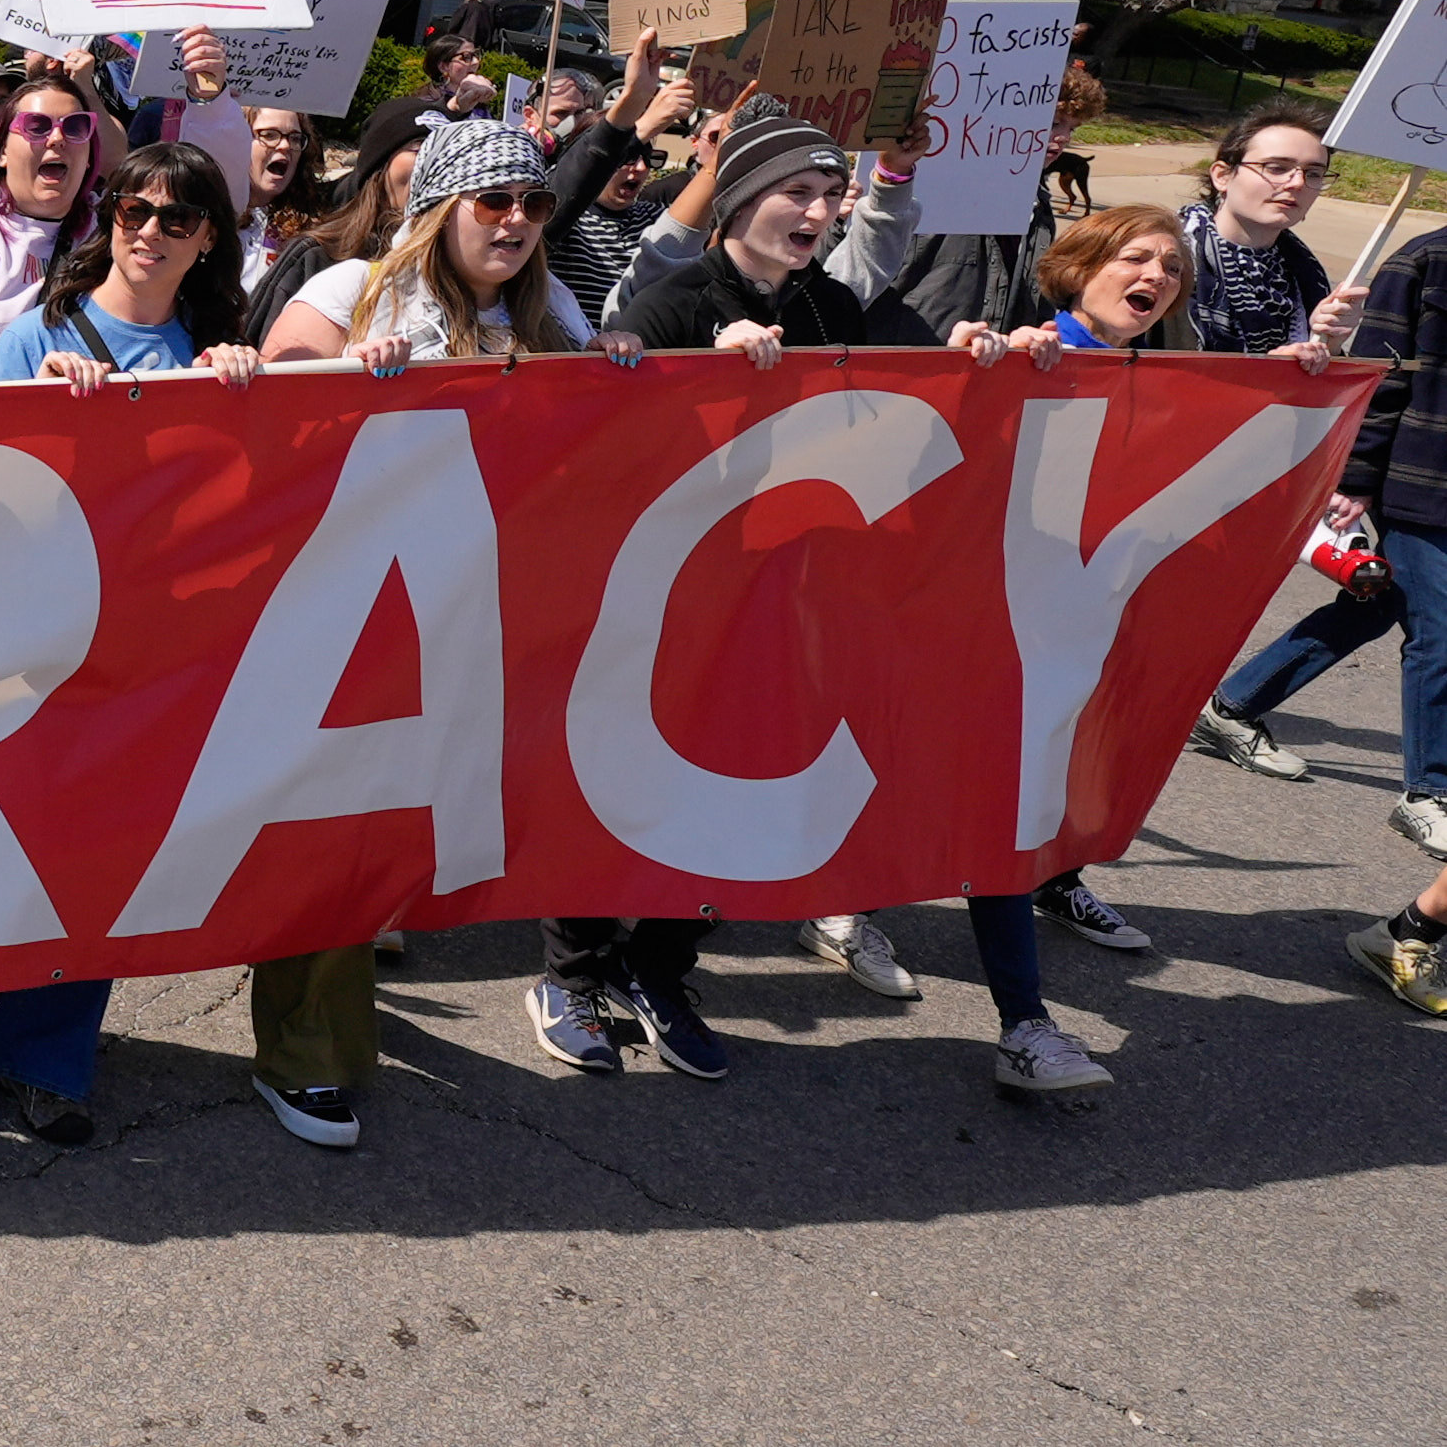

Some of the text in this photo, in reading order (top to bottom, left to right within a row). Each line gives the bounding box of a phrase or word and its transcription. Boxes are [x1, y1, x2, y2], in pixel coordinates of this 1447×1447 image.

[251, 38, 269, 49] of
[969, 14, 1071, 55] fascists
[790, 51, 813, 85] to
[827, 52, 858, 85] the
